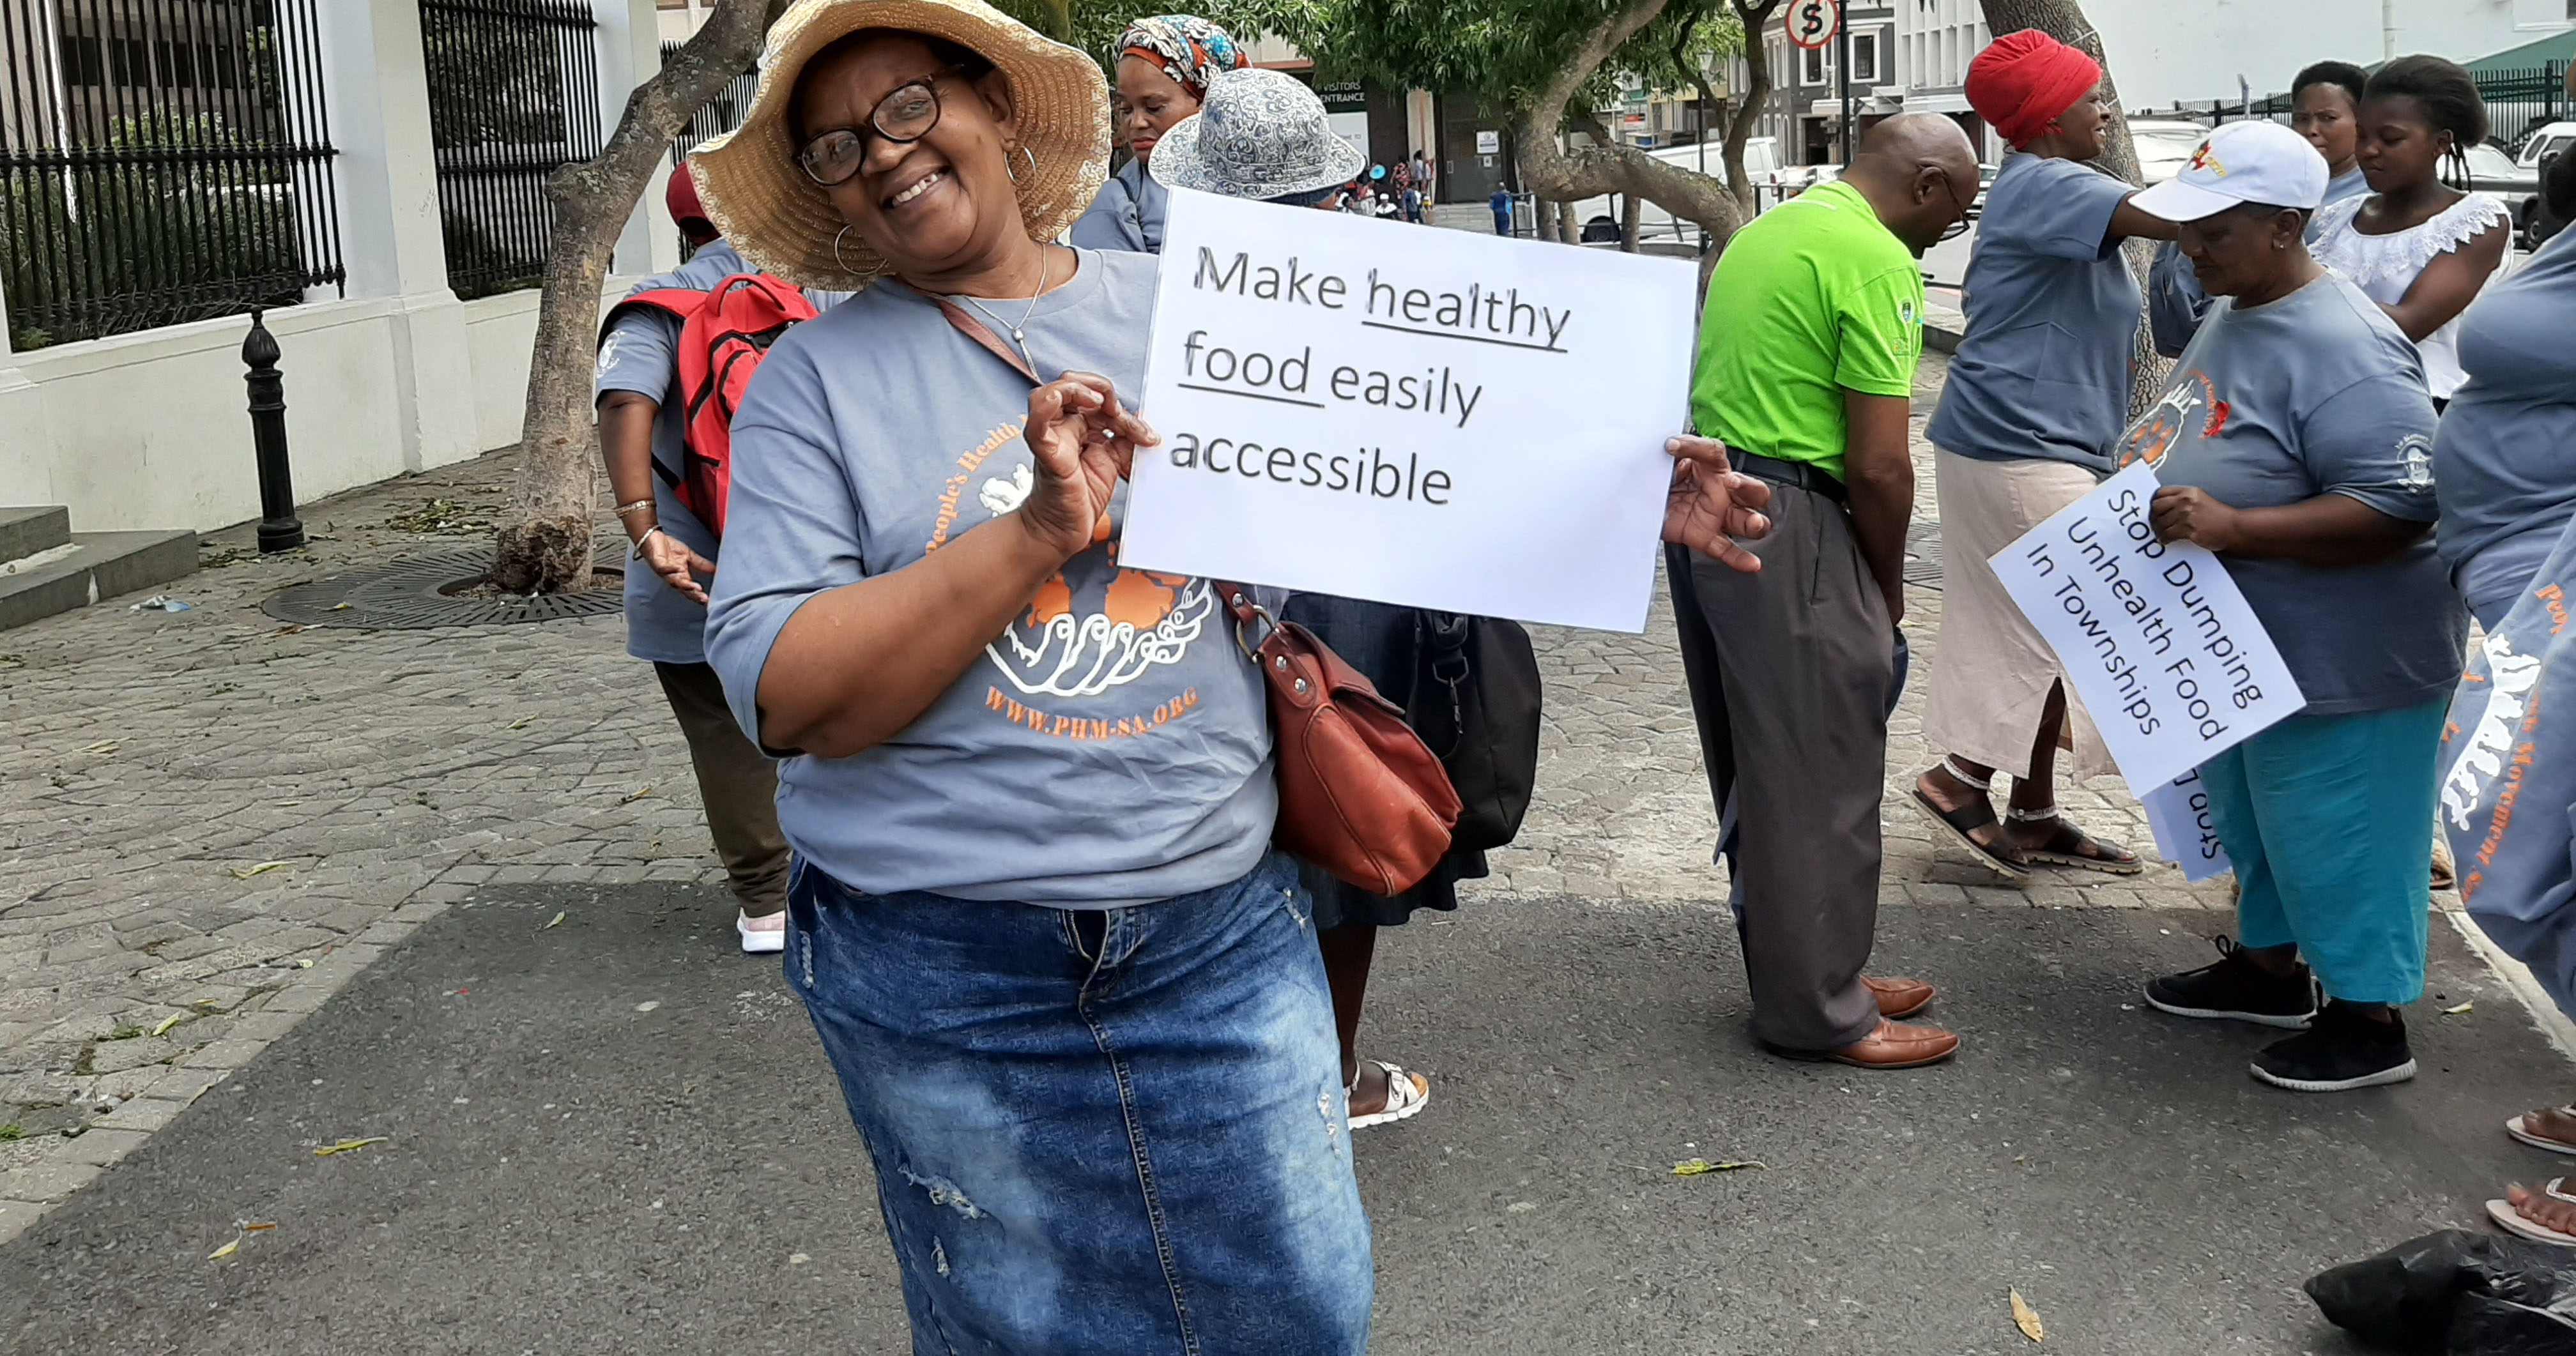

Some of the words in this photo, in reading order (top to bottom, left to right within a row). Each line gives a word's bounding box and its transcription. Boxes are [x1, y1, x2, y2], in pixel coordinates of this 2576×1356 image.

[1320, 92, 1365, 102] ENTRANCE
[1193, 245, 1346, 309] Make
[1367, 268, 1571, 351] healthy
[1184, 330, 1310, 393] food
[1331, 366, 1483, 429] easily
[957, 422, 1021, 472] Health
[1170, 432, 1452, 505] accessible
[2027, 543, 2054, 577] In
[2055, 575, 2161, 736] Townships
[2067, 517, 2173, 656] Unhealth
[2165, 657, 2228, 742] Food
[2107, 489, 2165, 560] Stop
[2163, 560, 2264, 710] Dumping
[985, 686, 1199, 741] WWW.PHM-SA.ORG
